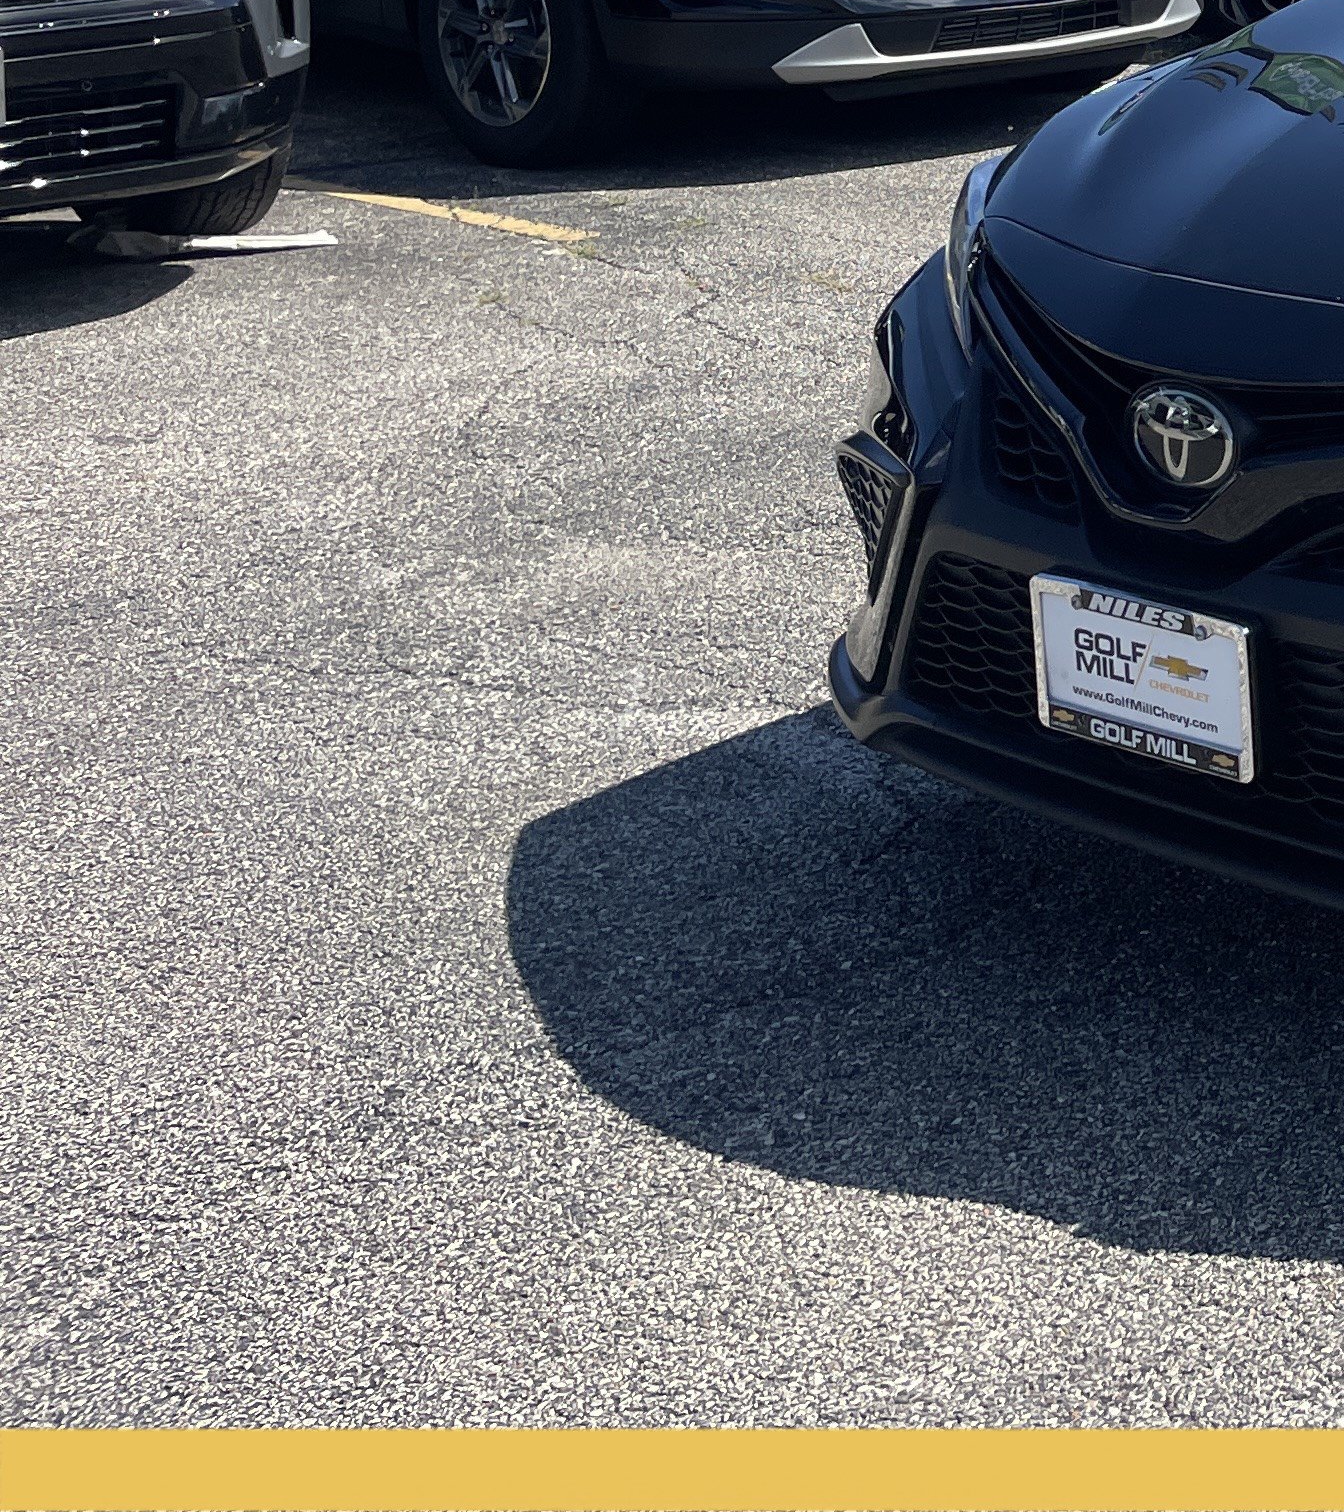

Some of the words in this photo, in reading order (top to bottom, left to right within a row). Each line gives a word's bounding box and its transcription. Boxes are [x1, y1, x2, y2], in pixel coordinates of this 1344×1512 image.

[1088, 593, 1186, 632] NILES
[1073, 627, 1147, 664] GOLF
[1075, 650, 1136, 686] MILL
[1072, 685, 1219, 734] www.GolfMillChevy.com
[1148, 678, 1210, 704] CHEVROLET
[1089, 718, 1144, 750] GOLF
[1146, 734, 1198, 766] MILL
